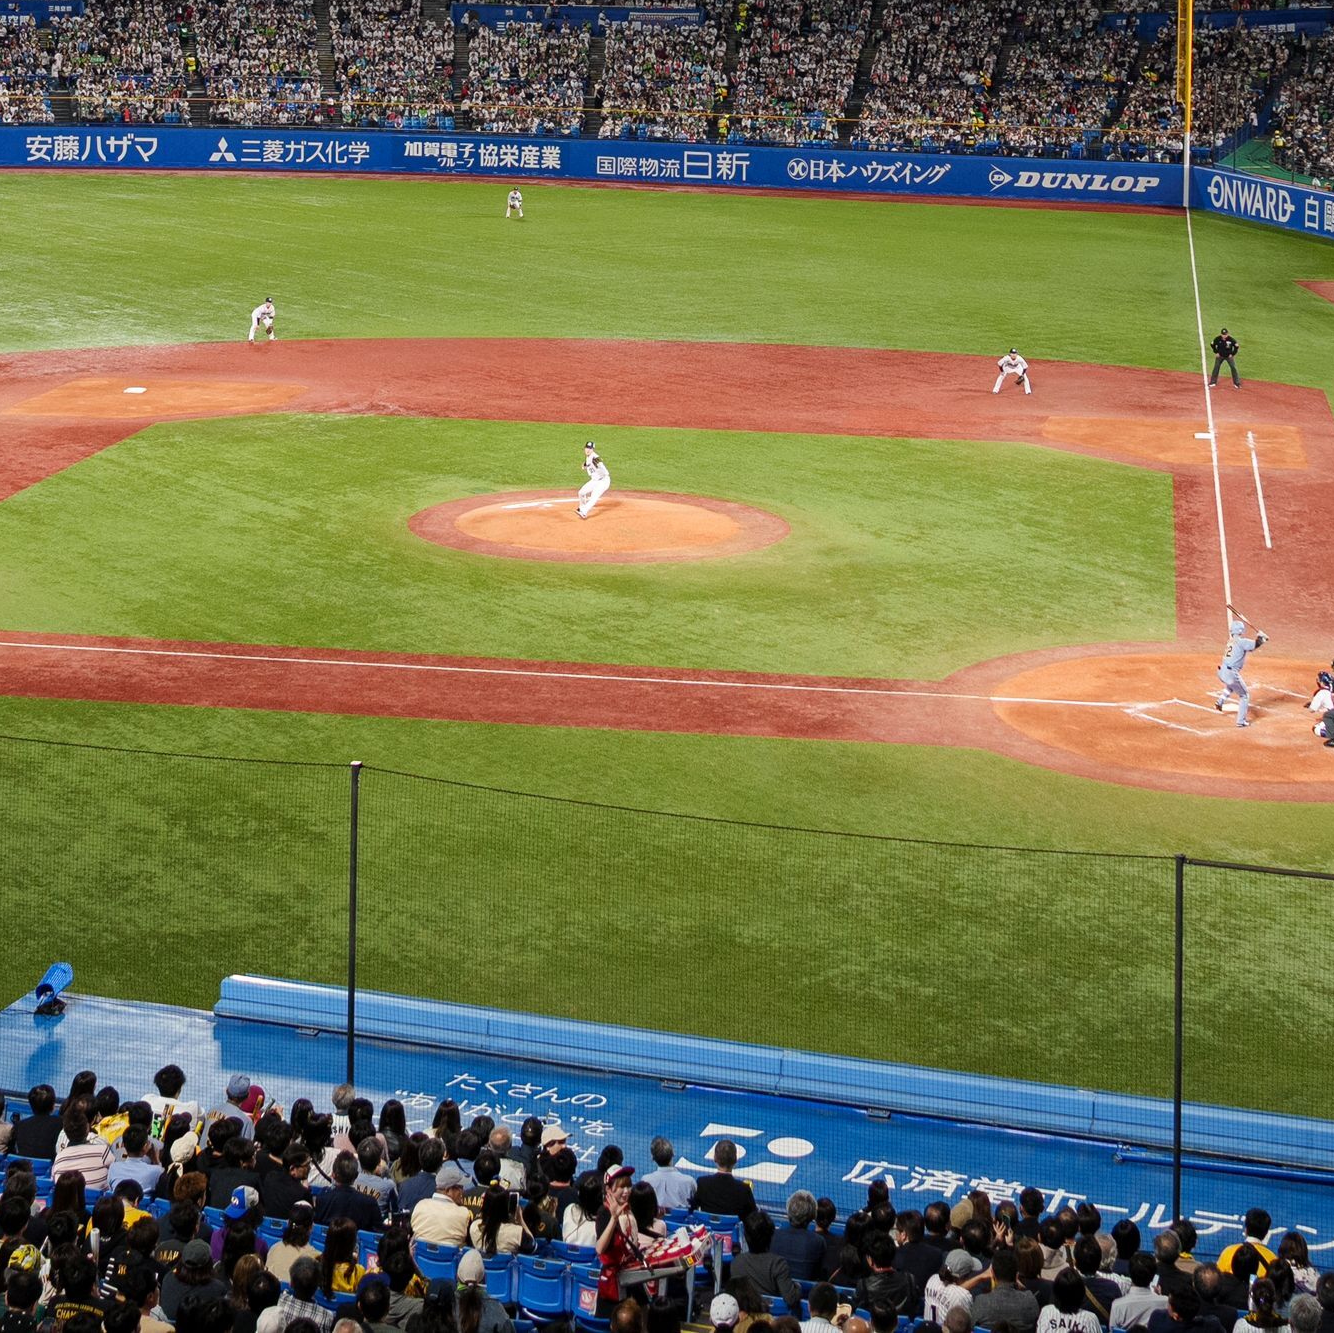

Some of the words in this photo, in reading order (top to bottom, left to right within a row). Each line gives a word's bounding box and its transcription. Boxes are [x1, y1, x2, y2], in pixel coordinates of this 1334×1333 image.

[25, 134, 158, 163] 安藤ハザマ
[240, 139, 370, 164] 三菱ガス化学
[404, 140, 476, 159] 加賀電子
[479, 144, 562, 170] 協栄産業
[437, 157, 475, 167] グループ
[595, 155, 680, 179] 国際物流
[683, 150, 750, 181] 日新
[809, 158, 951, 185] 日本ハウズイング
[1014, 170, 1160, 193] DUNLOP
[1207, 174, 1296, 223] ONWARD
[444, 1071, 607, 1109] たくさんの
